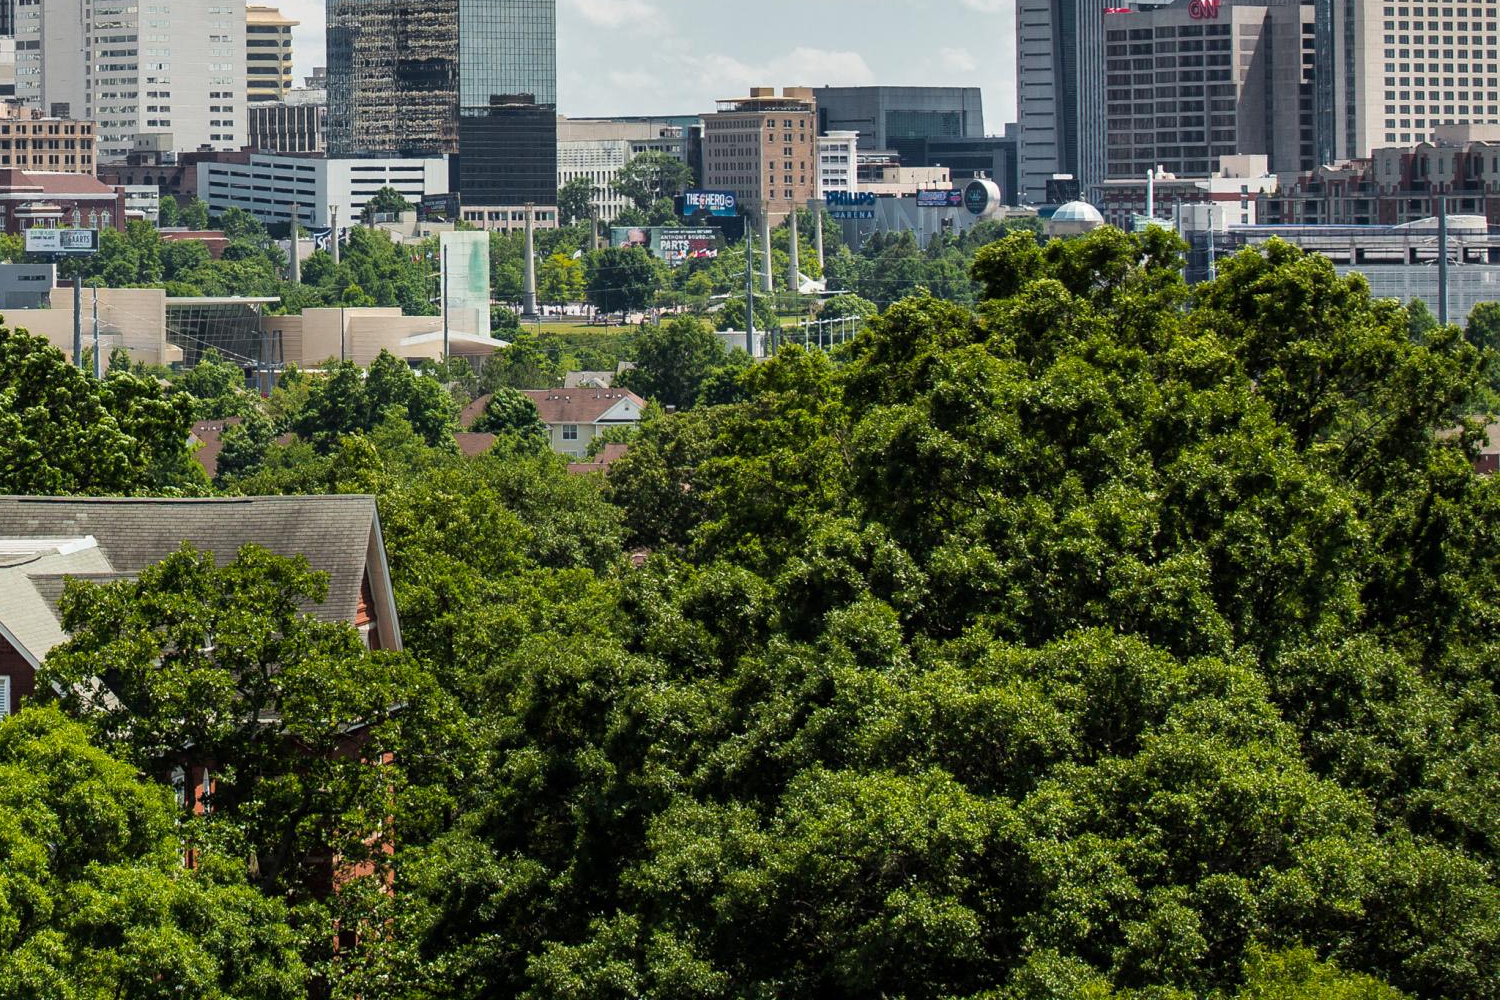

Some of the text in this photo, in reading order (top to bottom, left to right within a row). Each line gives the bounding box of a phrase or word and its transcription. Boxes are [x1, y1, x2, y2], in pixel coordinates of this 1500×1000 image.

[686, 193, 700, 206] THE
[705, 193, 725, 206] HERO
[824, 190, 876, 206] PHILIPS
[840, 210, 873, 219] ARENA
[660, 240, 690, 250] PARTS
